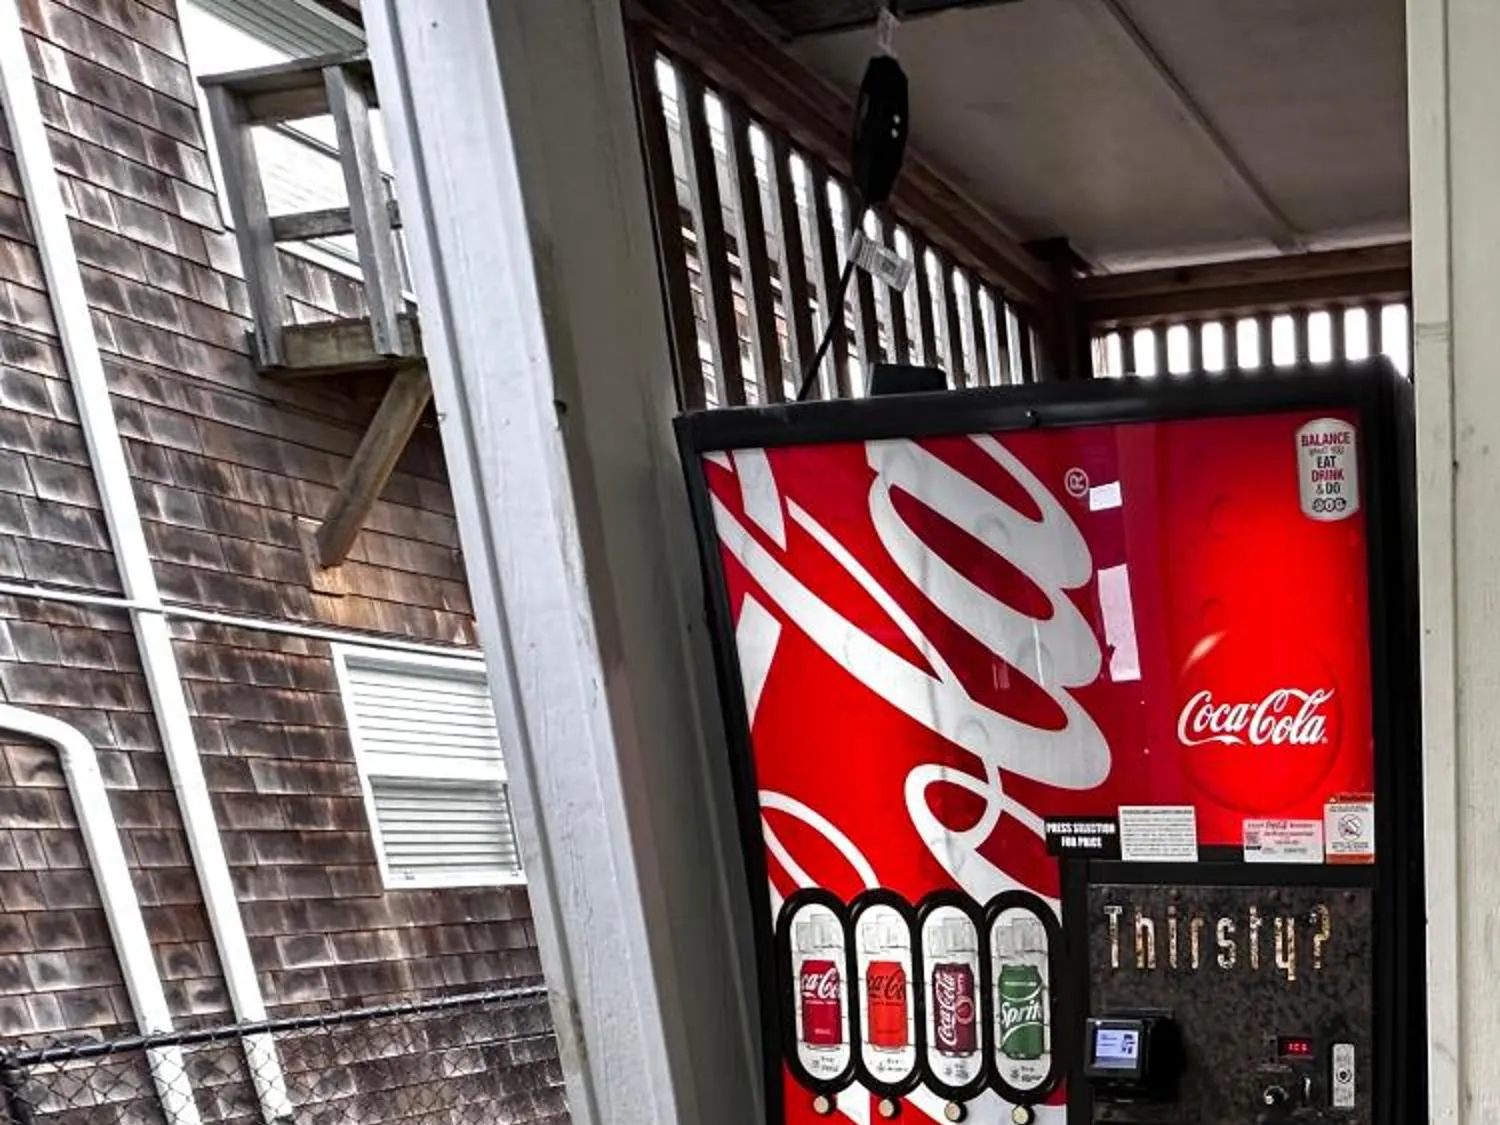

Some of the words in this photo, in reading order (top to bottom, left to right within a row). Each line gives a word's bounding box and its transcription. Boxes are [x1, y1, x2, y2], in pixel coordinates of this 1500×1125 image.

[1301, 431, 1351, 447] BALANCE
[1316, 455, 1337, 469] EAT
[1311, 468, 1345, 483] DRINK
[1325, 481, 1341, 495] DO
[1177, 687, 1336, 747] Coca-Cola
[1046, 822, 1073, 834] PRESS
[1073, 822, 1116, 835] SELECTION
[1061, 836, 1077, 848] FOR
[1077, 836, 1103, 848] PRICE
[1103, 903, 1332, 982] Thirsty?
[935, 968, 958, 1047] Coca-Cola
